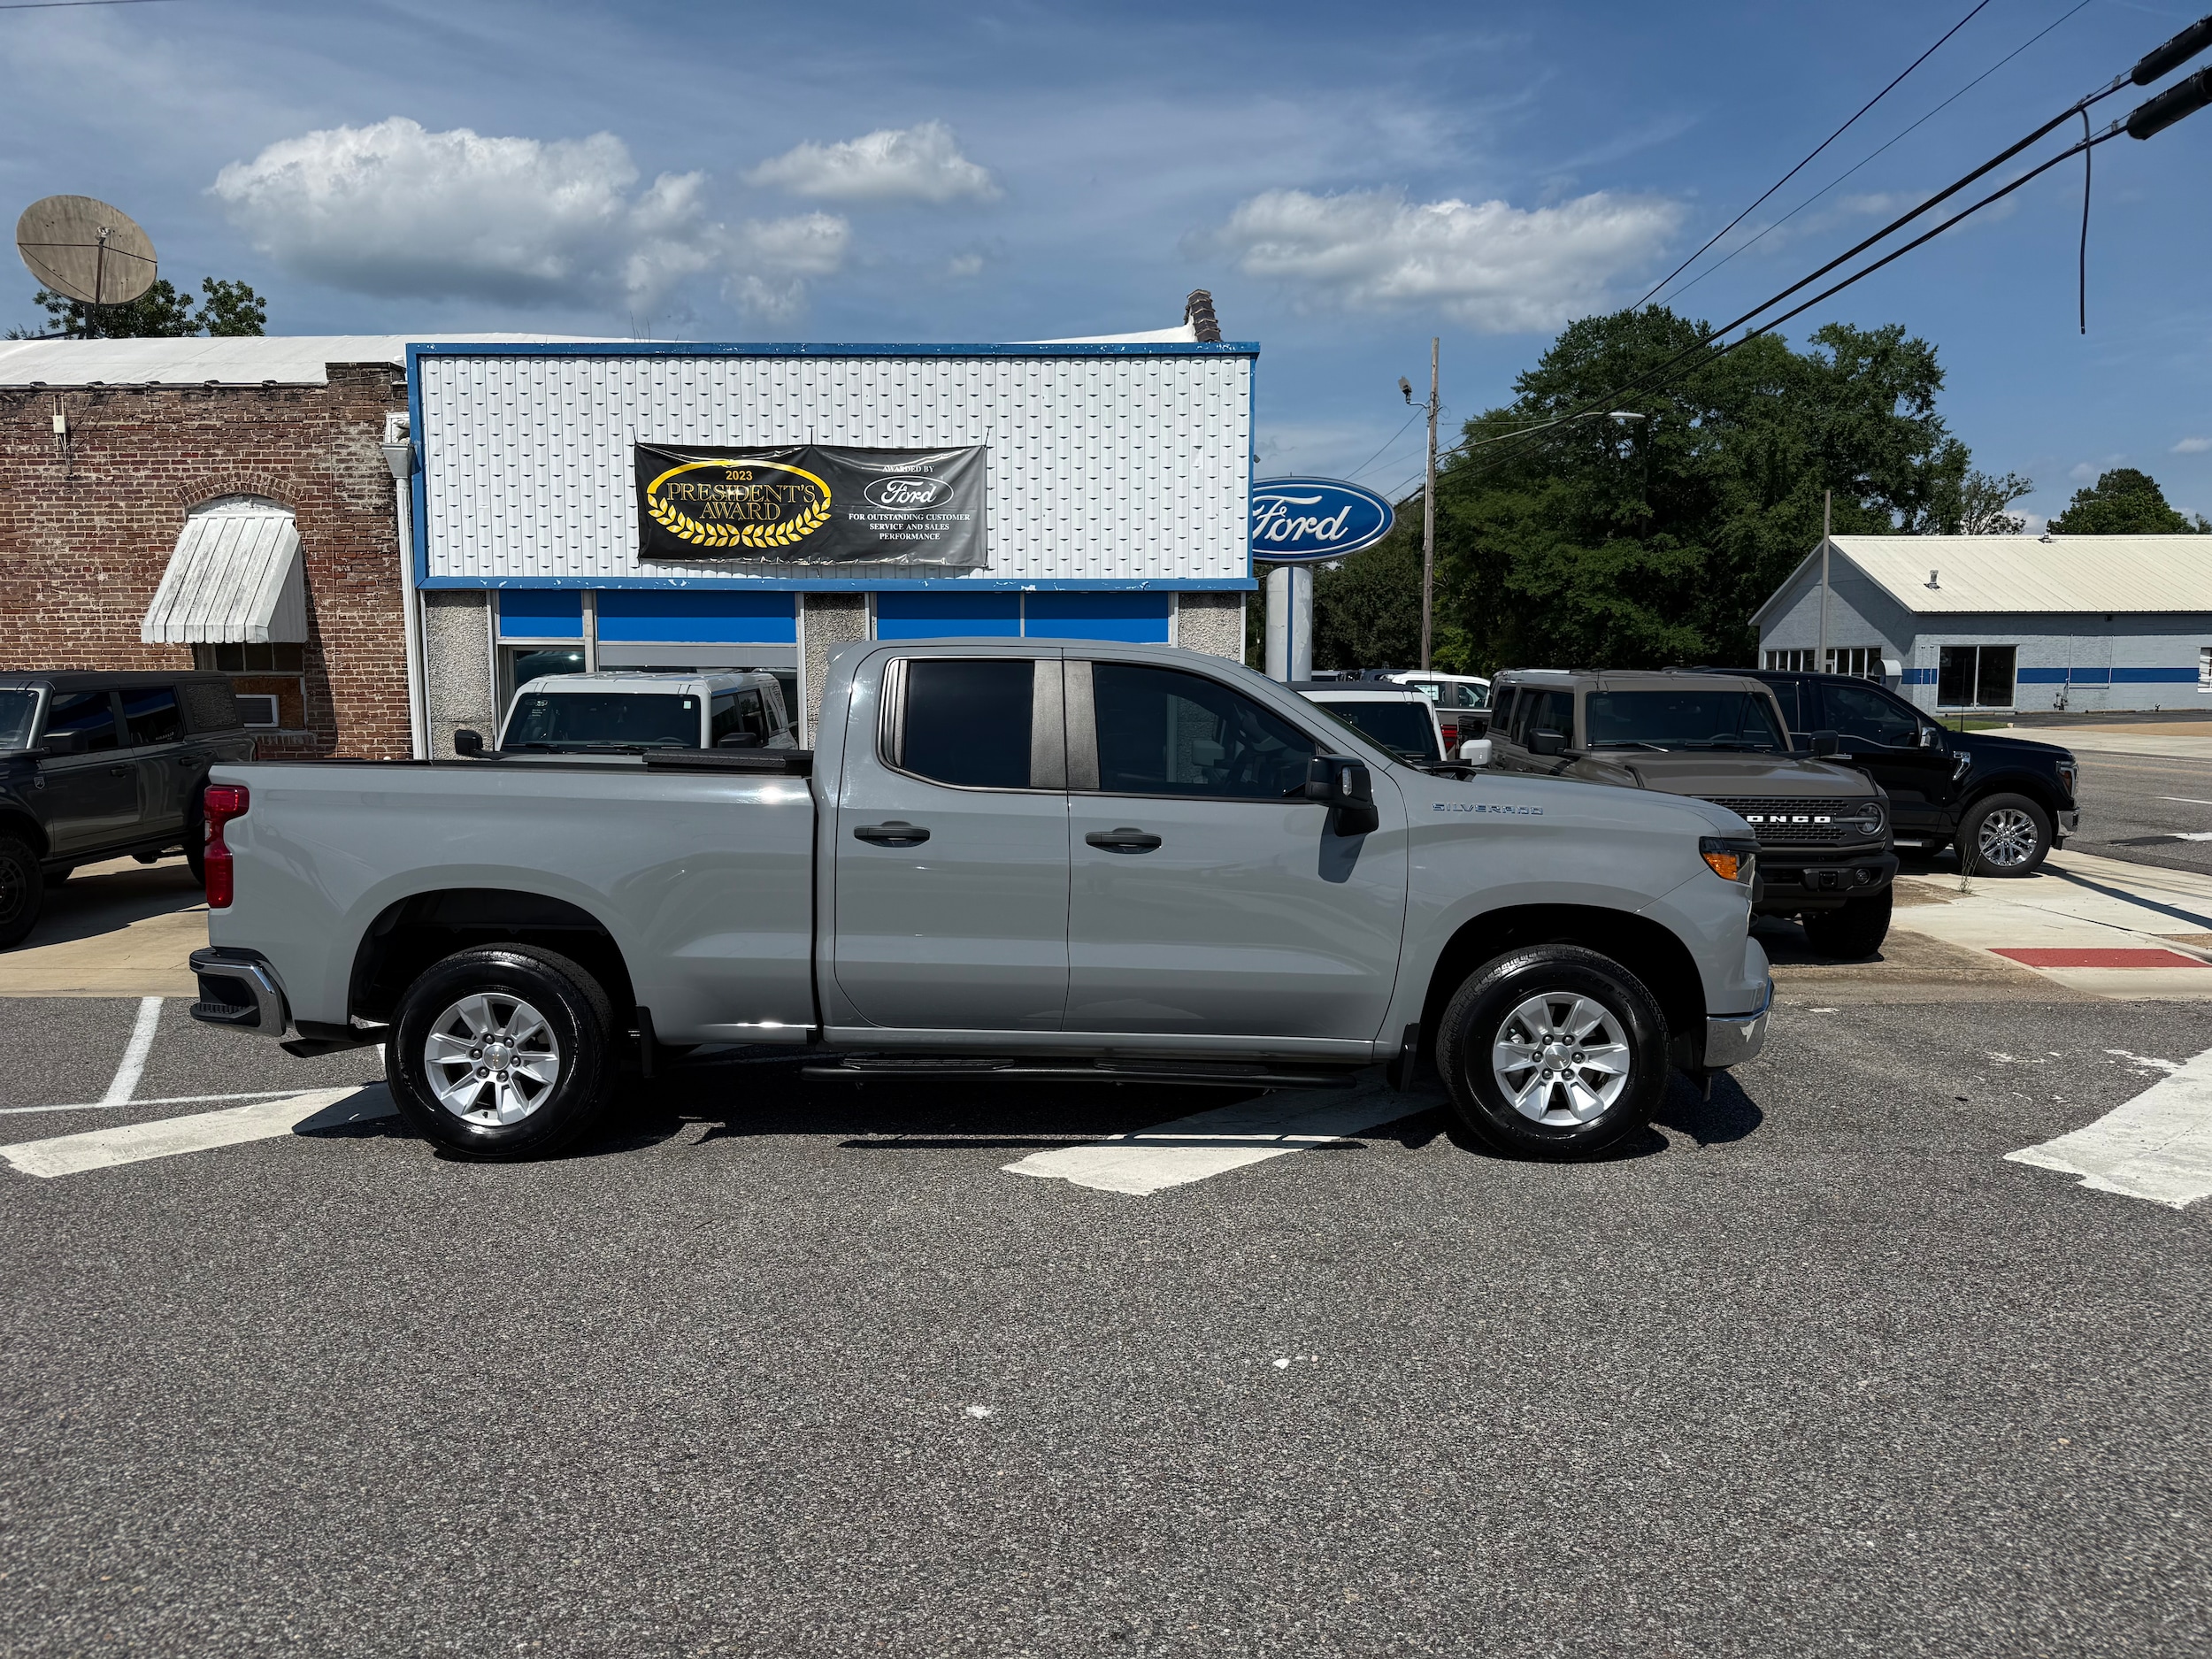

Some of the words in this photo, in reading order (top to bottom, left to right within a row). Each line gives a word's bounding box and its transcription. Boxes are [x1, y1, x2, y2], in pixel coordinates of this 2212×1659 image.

[726, 470, 753, 480] 2023
[666, 482, 816, 503] PRESIDENT'S
[880, 480, 937, 503] Ford
[699, 502, 781, 520] AWARD
[1253, 495, 1352, 541] Ford
[1432, 802, 1544, 815] SILVERADO
